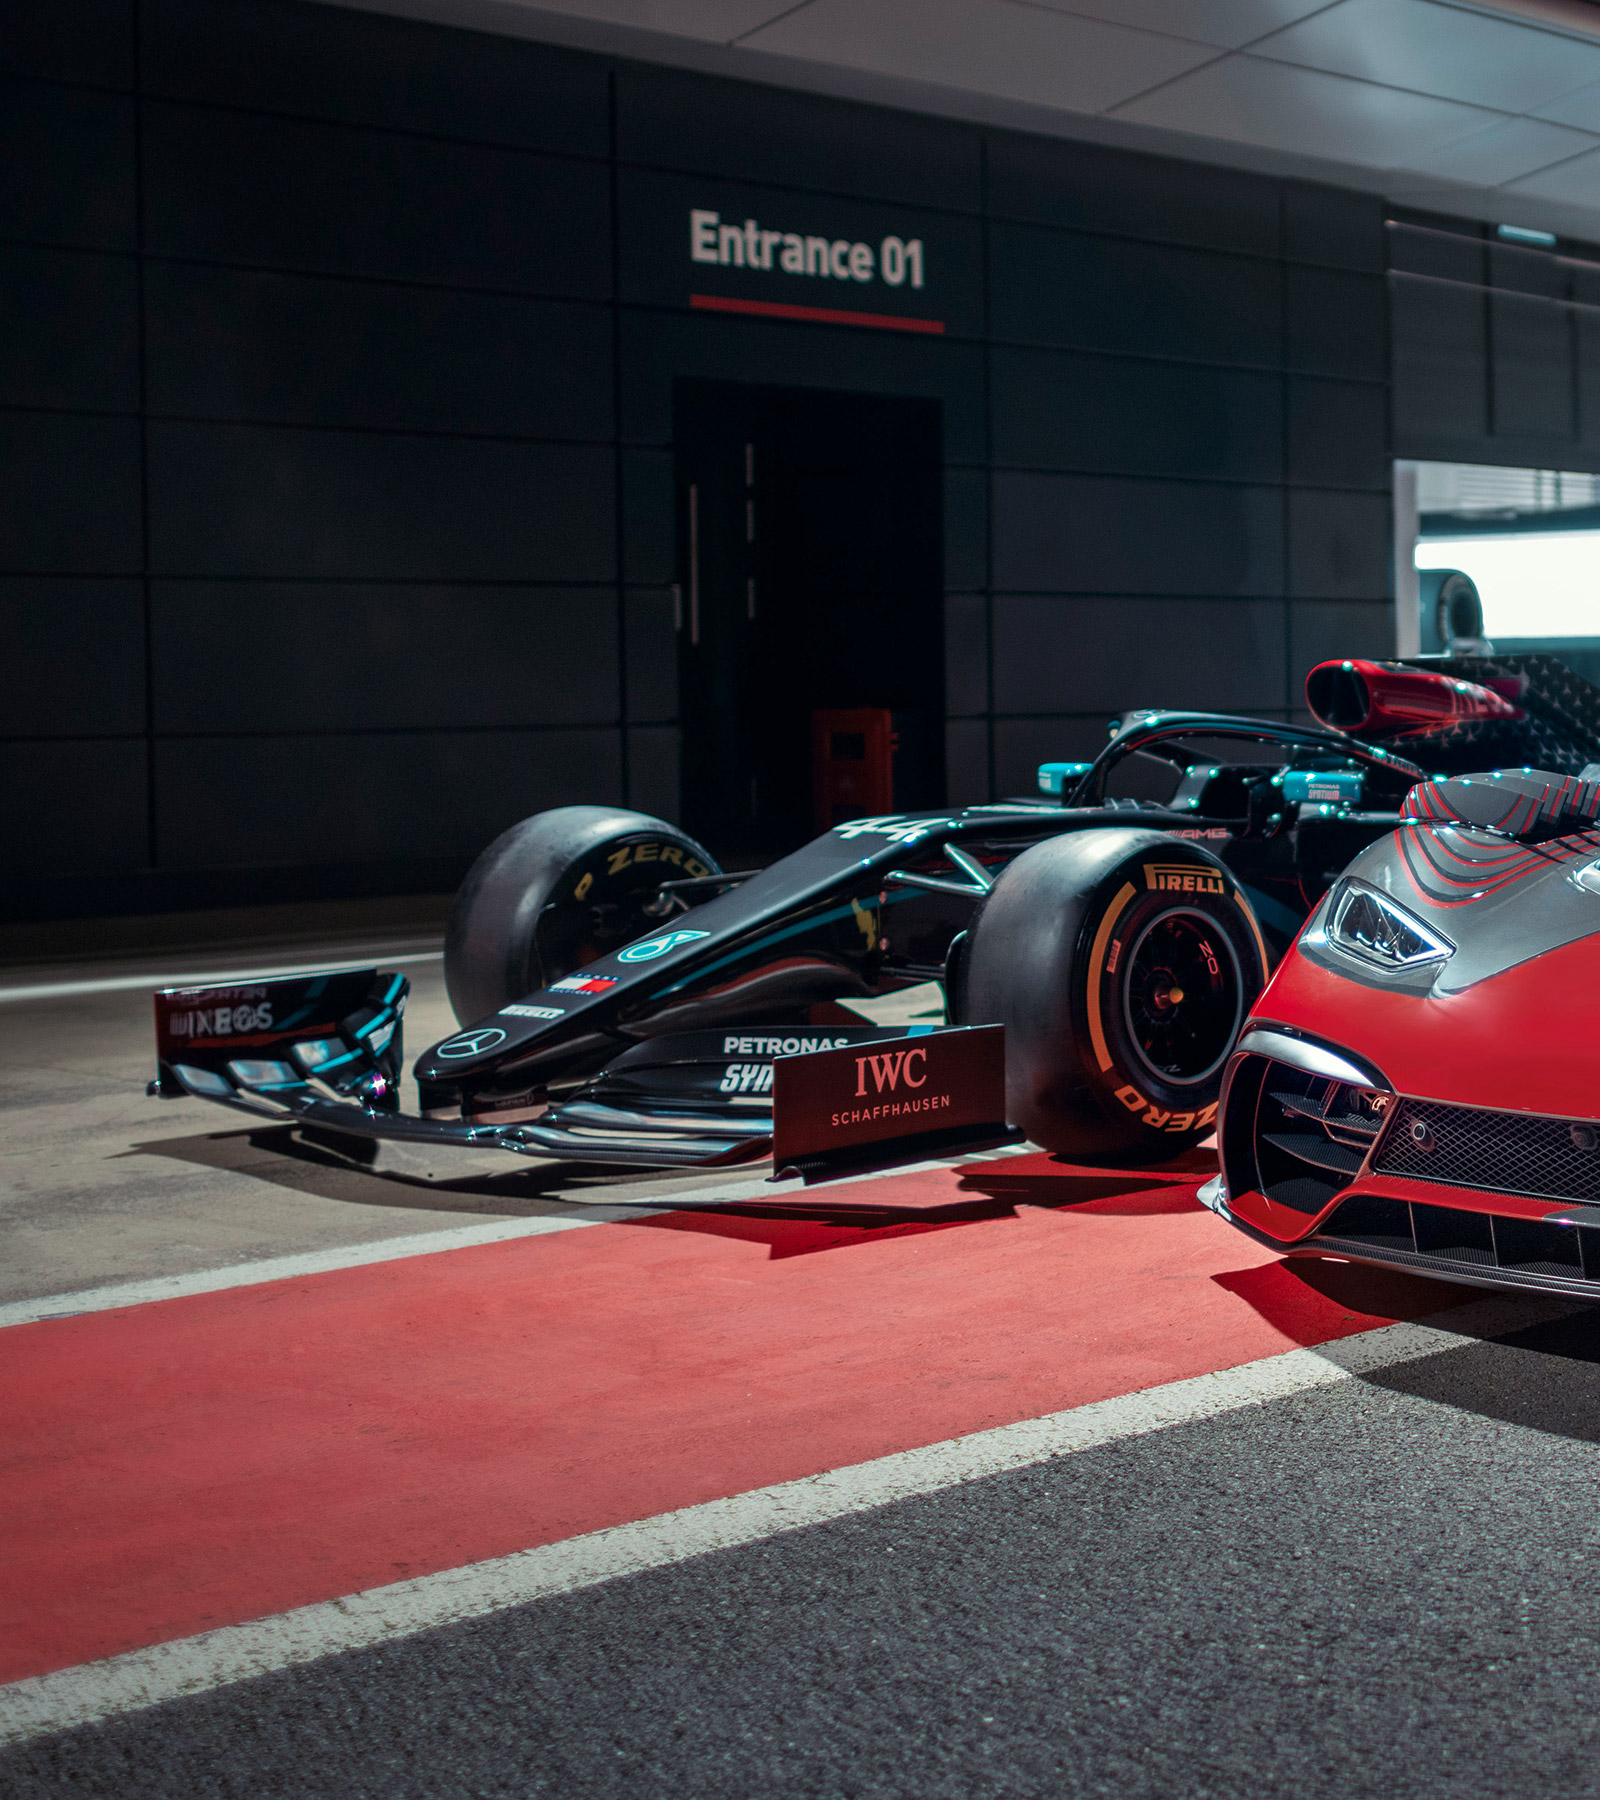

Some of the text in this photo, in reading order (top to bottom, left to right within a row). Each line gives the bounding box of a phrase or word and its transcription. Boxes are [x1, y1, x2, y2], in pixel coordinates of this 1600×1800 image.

[690, 207, 924, 289] Entrance 01
[833, 815, 953, 841] 44
[1181, 828, 1227, 839] AMG
[607, 843, 710, 878] ZERO
[1143, 864, 1224, 894] PIRELLI
[724, 1036, 848, 1054] PETRONAS
[855, 1047, 927, 1097] IWC
[831, 1094, 950, 1126] SCHAFFHAUSEN
[1114, 1084, 1219, 1132] ZERO
